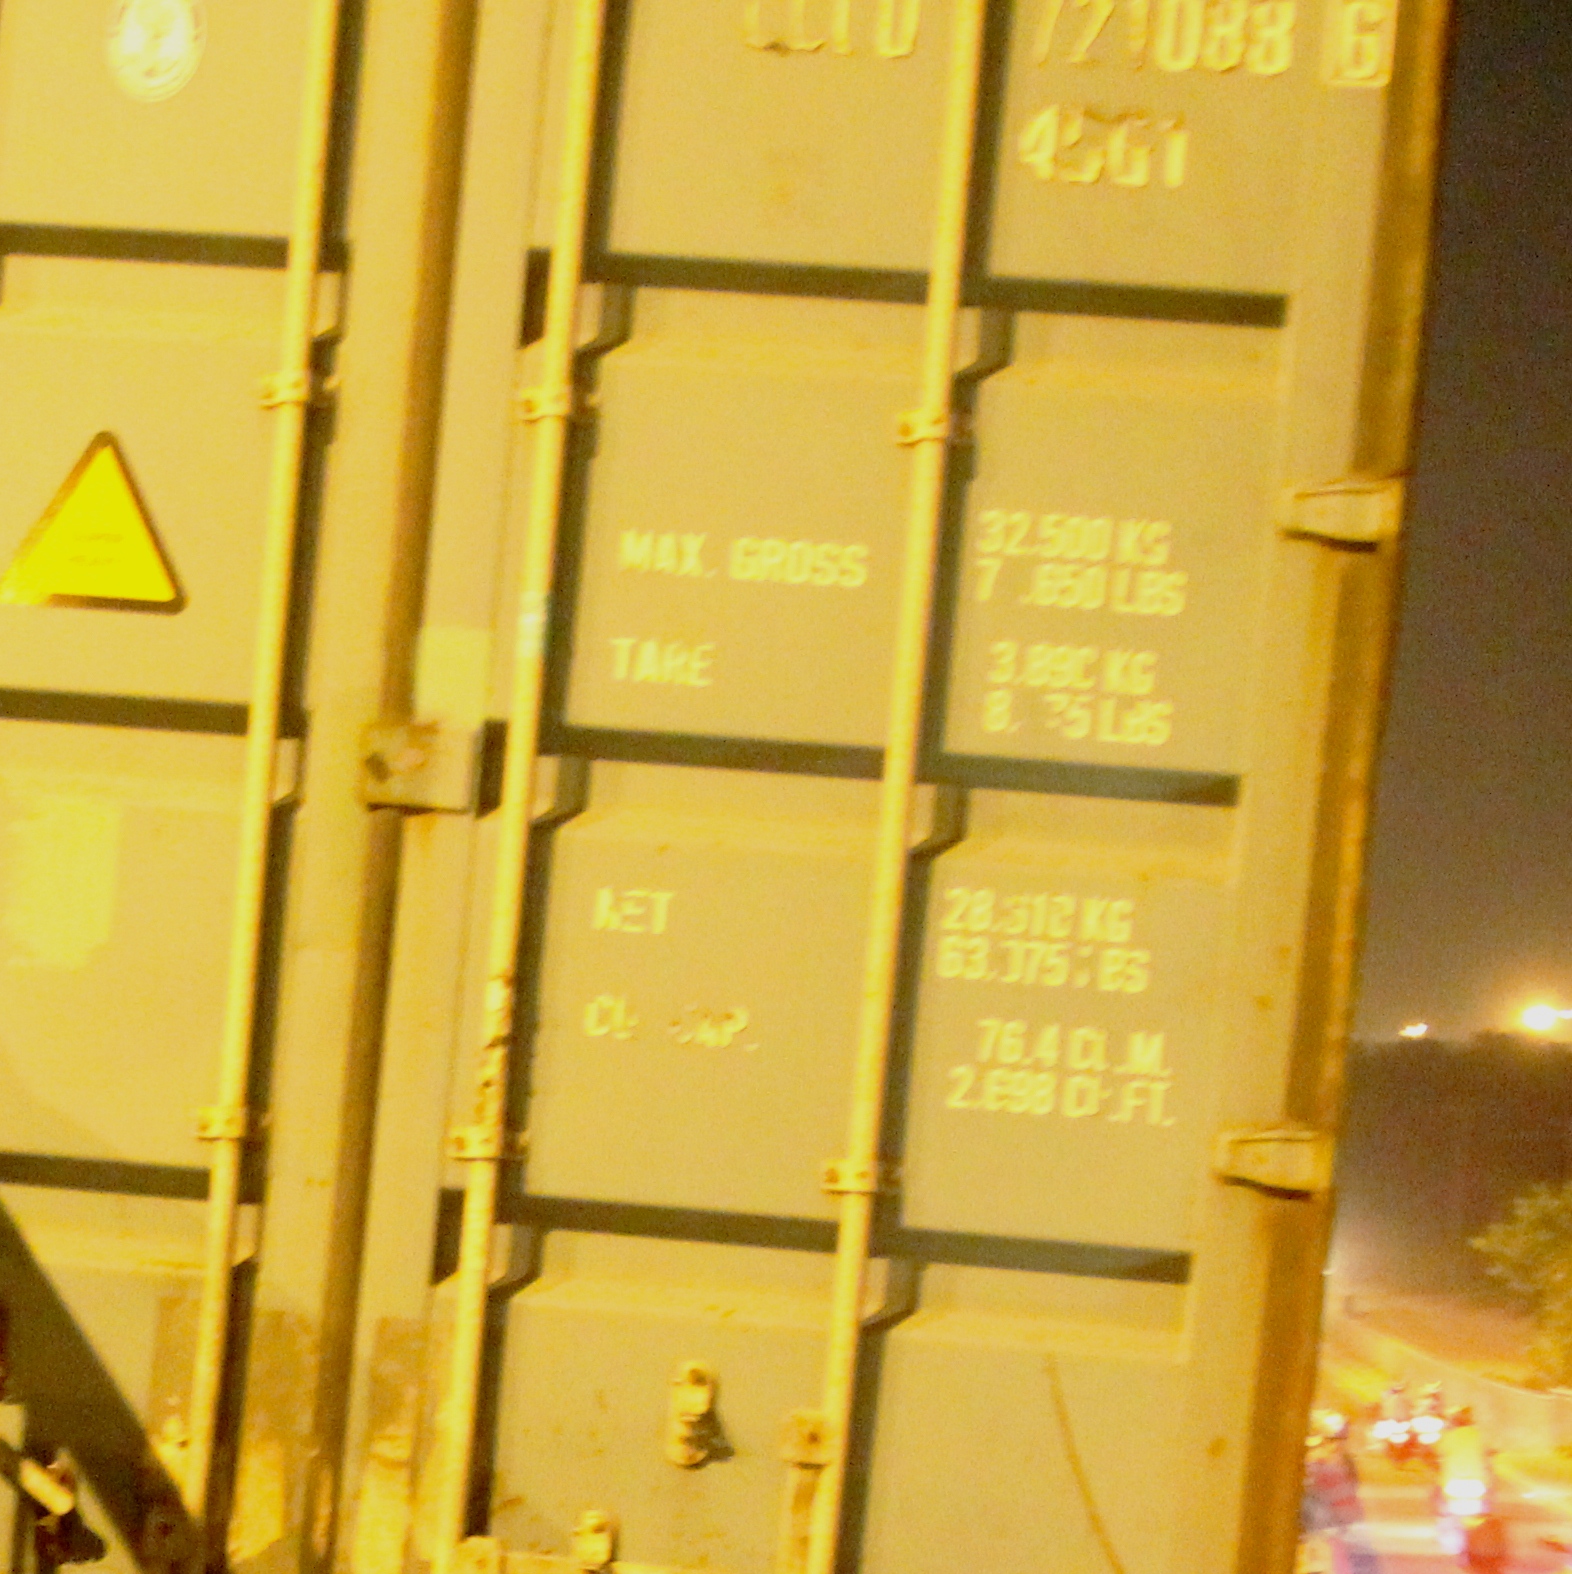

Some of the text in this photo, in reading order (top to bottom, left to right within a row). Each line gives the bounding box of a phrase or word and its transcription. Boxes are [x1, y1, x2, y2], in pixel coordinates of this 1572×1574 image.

[729, 536, 869, 588] GROSS
[1111, 568, 1188, 616] LBS
[1079, 898, 1135, 943] KG
